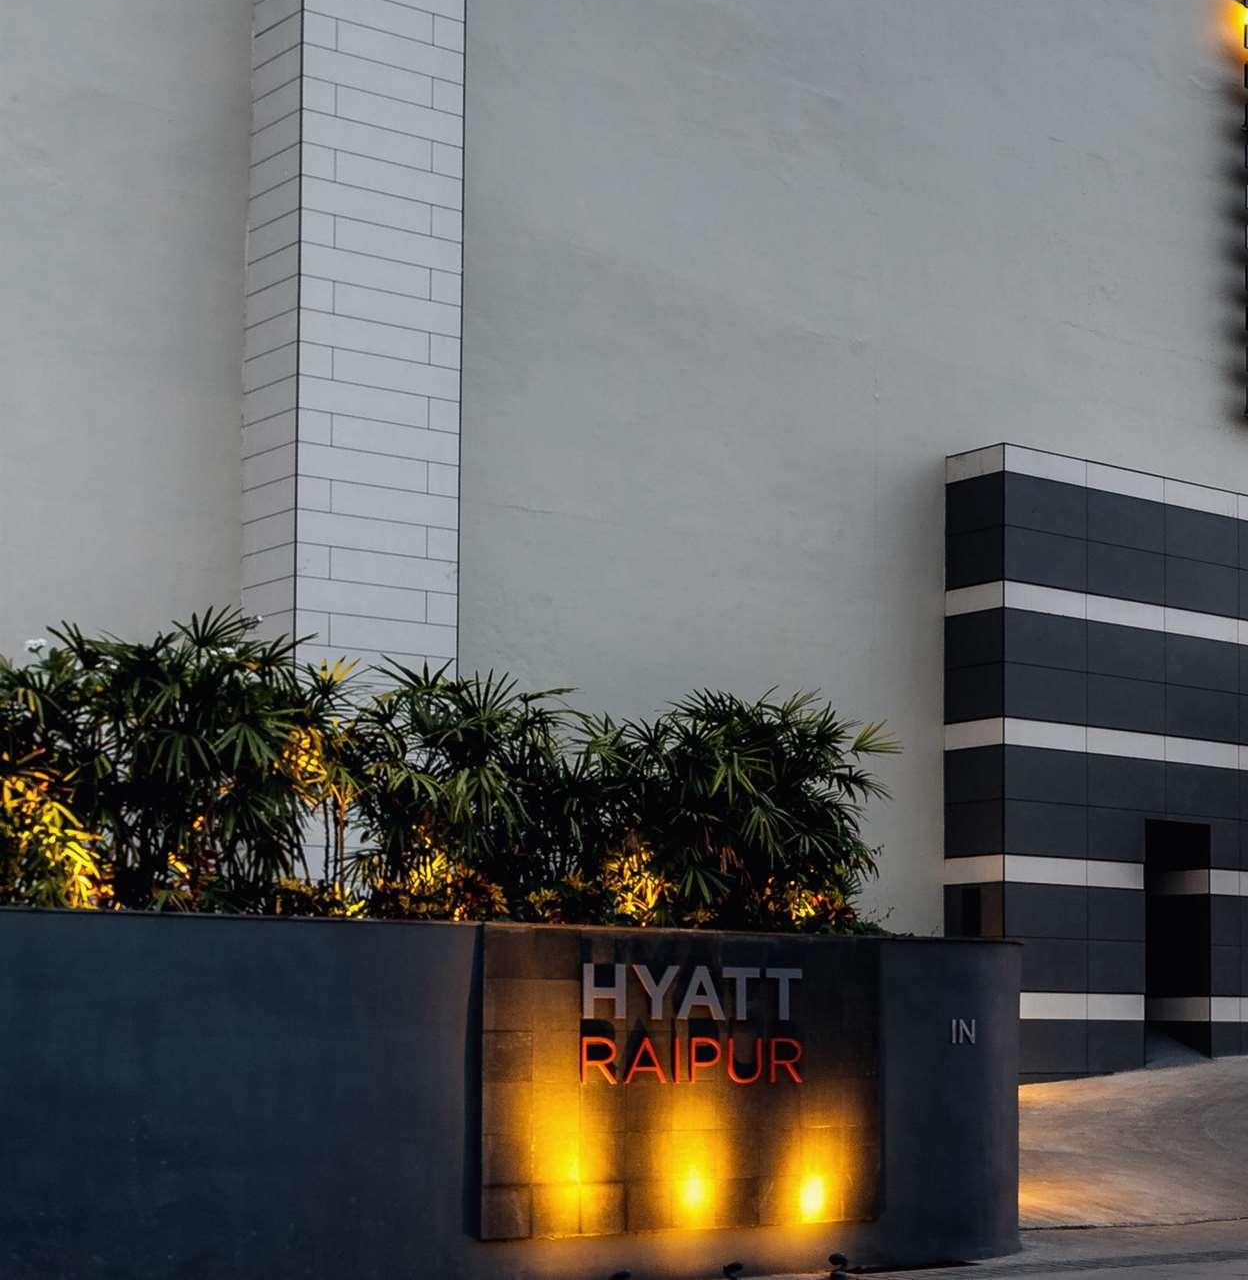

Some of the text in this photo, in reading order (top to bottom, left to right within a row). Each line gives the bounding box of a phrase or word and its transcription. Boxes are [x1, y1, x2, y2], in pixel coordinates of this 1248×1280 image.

[582, 962, 803, 1021] HYATT
[951, 1018, 976, 1044] IN
[580, 1036, 803, 1085] RAIPUR
